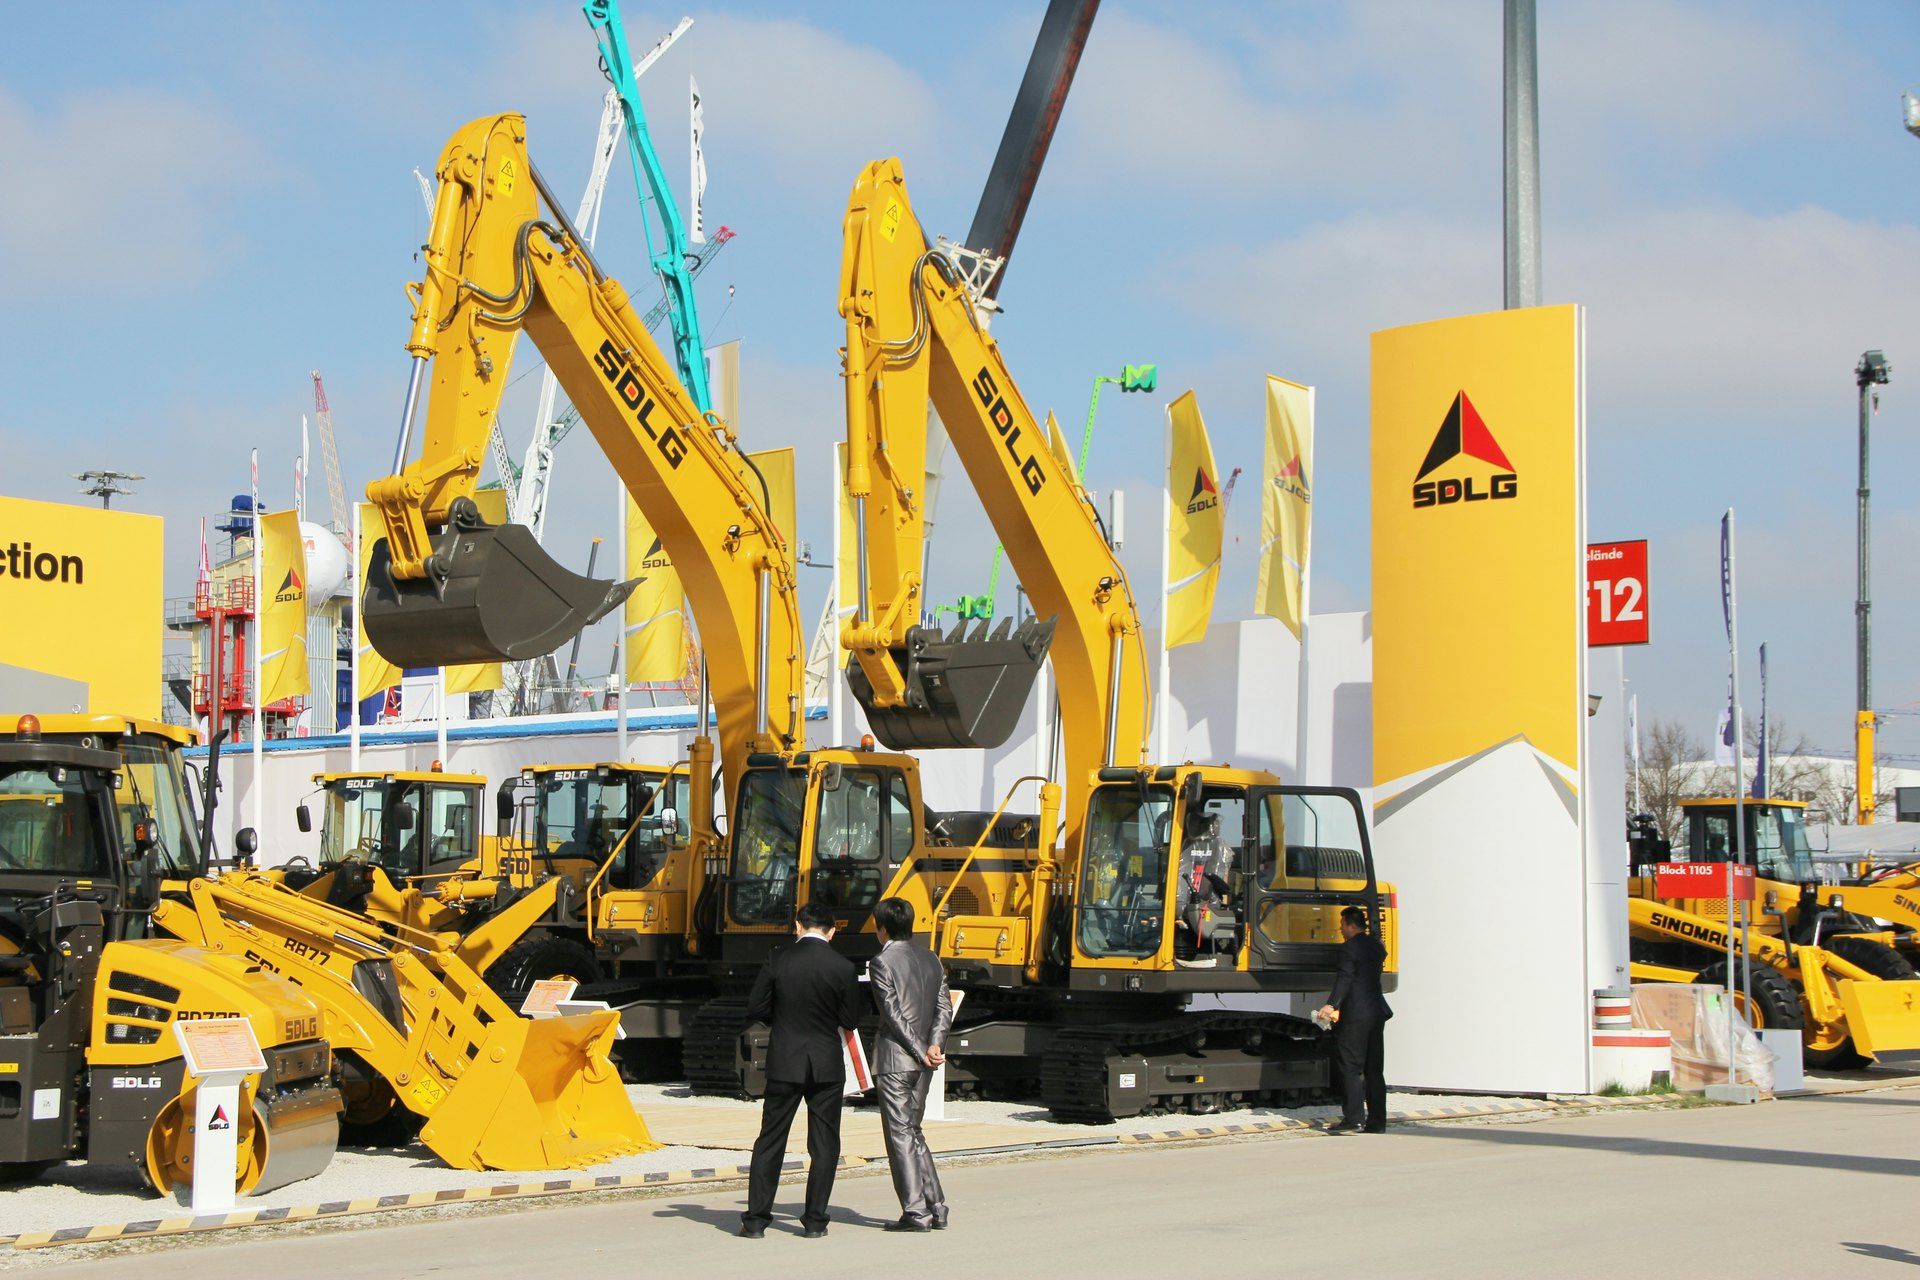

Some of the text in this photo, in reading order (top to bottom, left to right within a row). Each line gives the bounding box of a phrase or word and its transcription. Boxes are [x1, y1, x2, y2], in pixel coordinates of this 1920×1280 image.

[594, 339, 688, 470] SDLG
[972, 366, 1045, 496] SDLG
[1412, 474, 1517, 508] SDLG
[642, 559, 673, 569] SDL
[1585, 577, 1643, 623] 12
[346, 779, 375, 789] SDLG
[554, 770, 589, 781] SDLG
[1659, 865, 1713, 875] Block 1105
[286, 1017, 317, 1041] SDLG
[113, 1077, 161, 1089] SDLG
